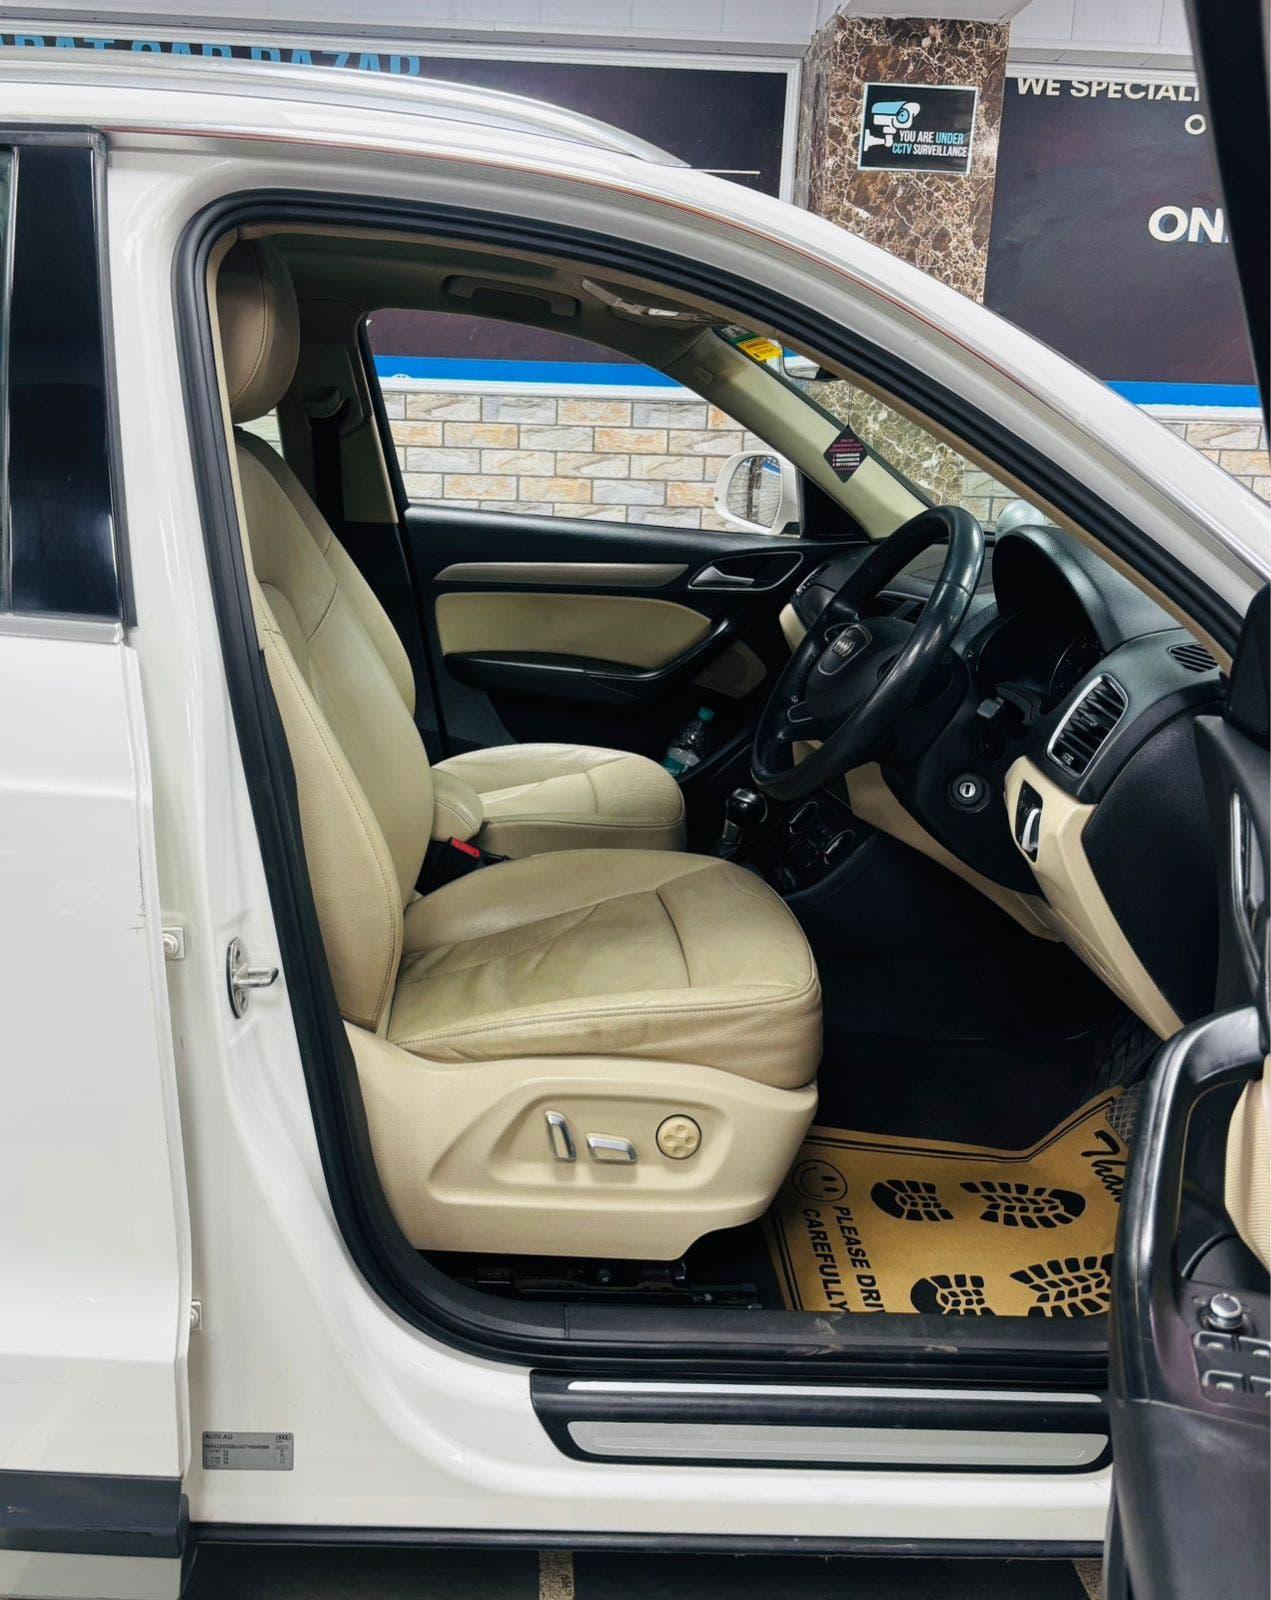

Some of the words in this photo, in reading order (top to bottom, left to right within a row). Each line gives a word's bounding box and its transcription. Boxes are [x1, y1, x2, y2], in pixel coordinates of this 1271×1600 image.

[1018, 77, 1060, 96] WE
[1070, 79, 1200, 102] SPECIALI
[892, 143, 913, 155] CCTV
[912, 144, 969, 158] SURVEILLANCE
[899, 129, 916, 143] YOU
[917, 131, 935, 144] ARE
[935, 131, 965, 145] UNDER
[1148, 205, 1229, 243] ON
[802, 1208, 851, 1313] CAREFULLY
[832, 1205, 872, 1270] PLEASE
[855, 1273, 887, 1313] DRI
